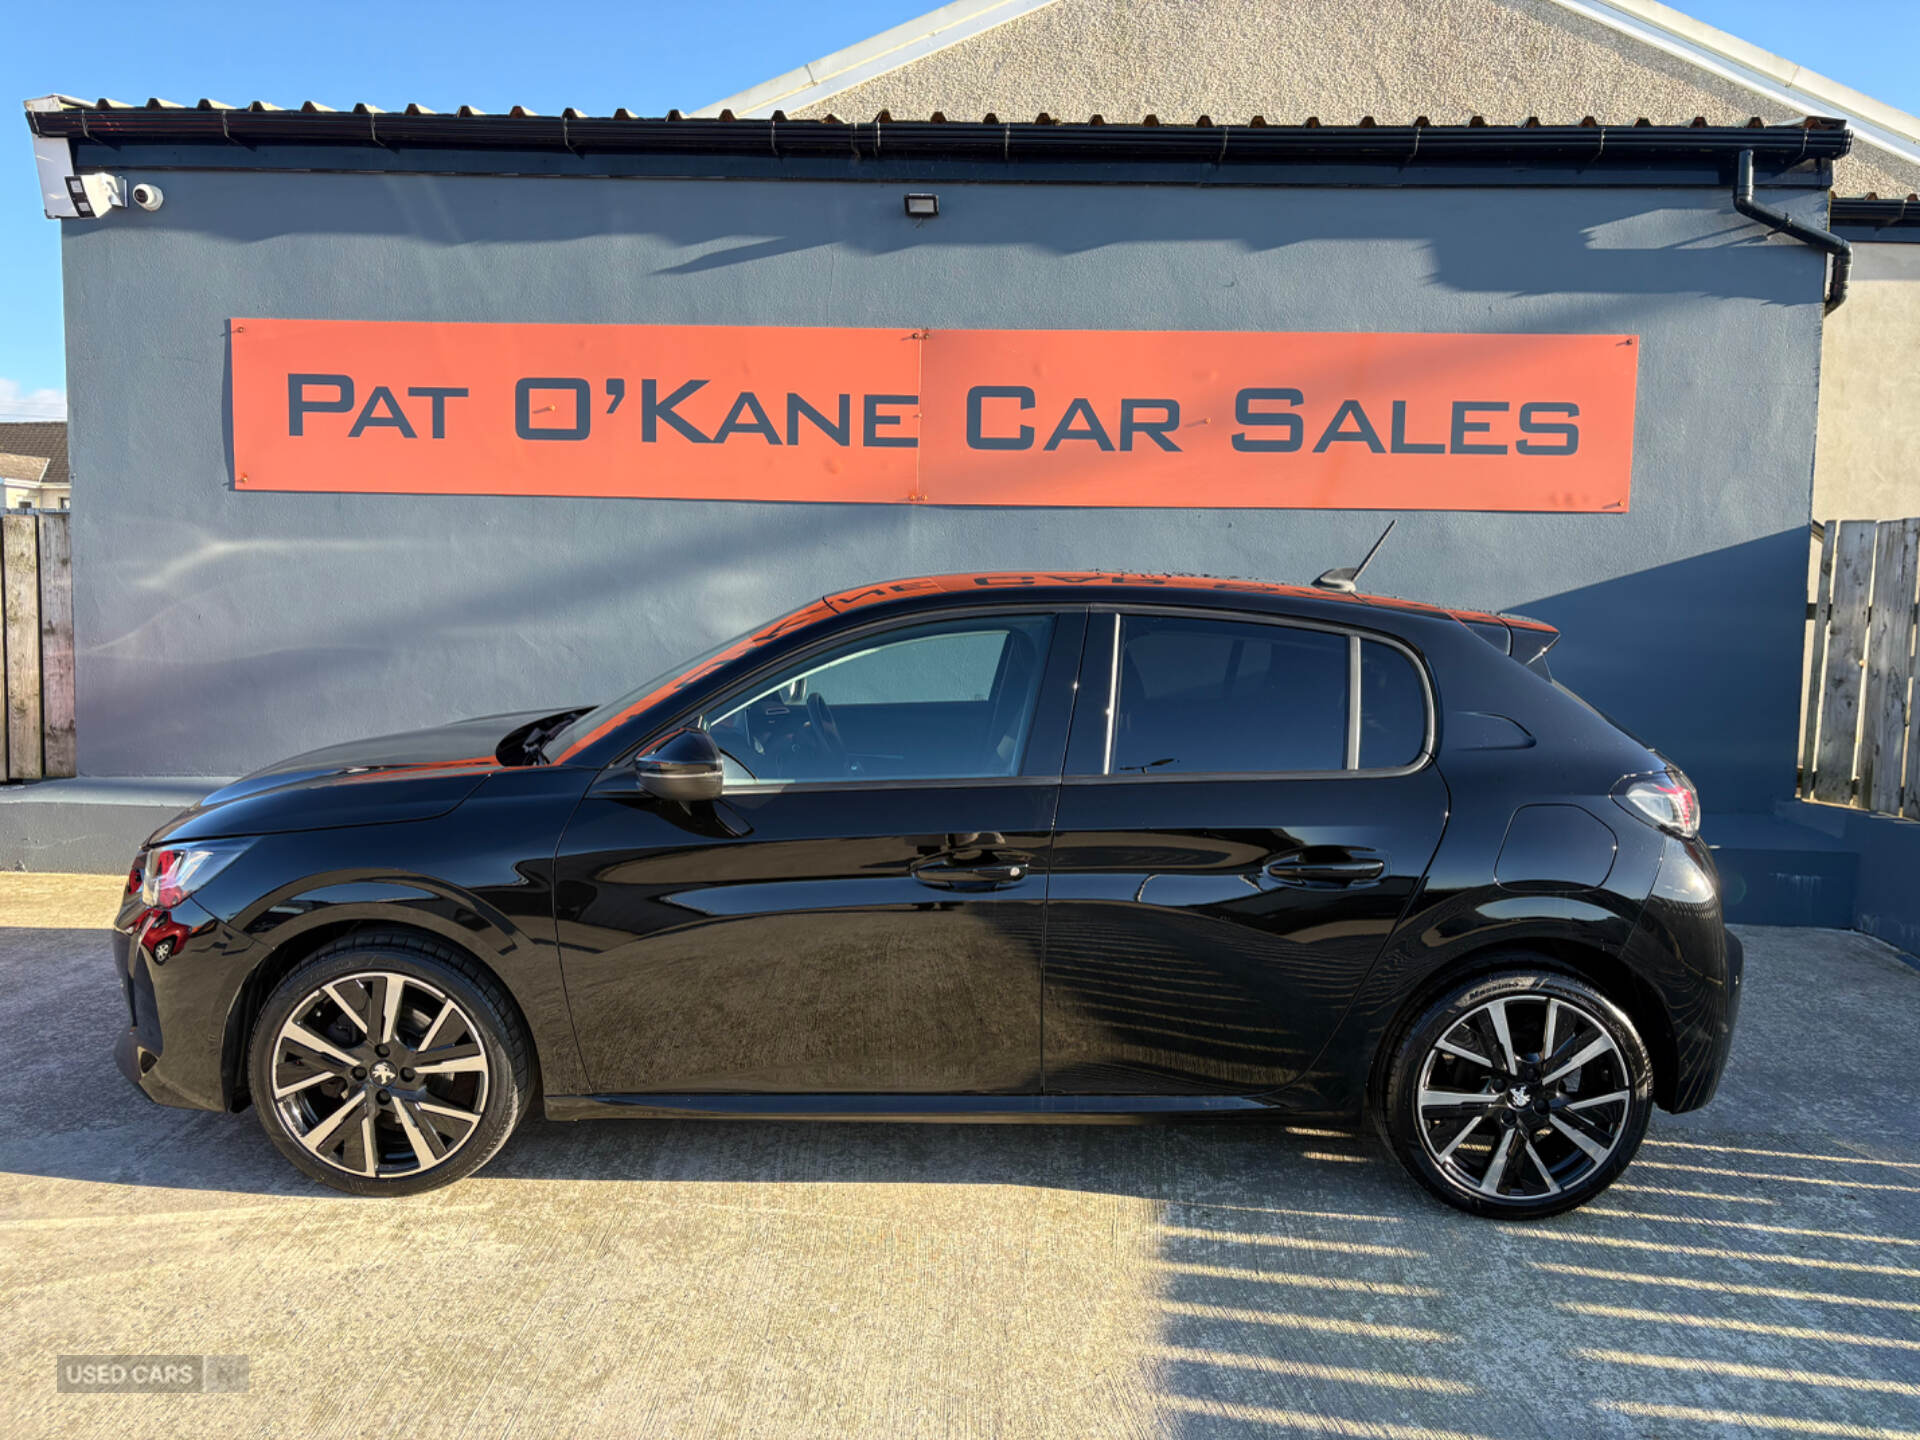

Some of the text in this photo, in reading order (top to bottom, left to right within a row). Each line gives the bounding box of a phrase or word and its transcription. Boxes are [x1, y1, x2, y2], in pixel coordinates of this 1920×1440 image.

[287, 373, 469, 440] PAT
[966, 385, 1183, 453] CAR
[1231, 387, 1580, 456] SALES
